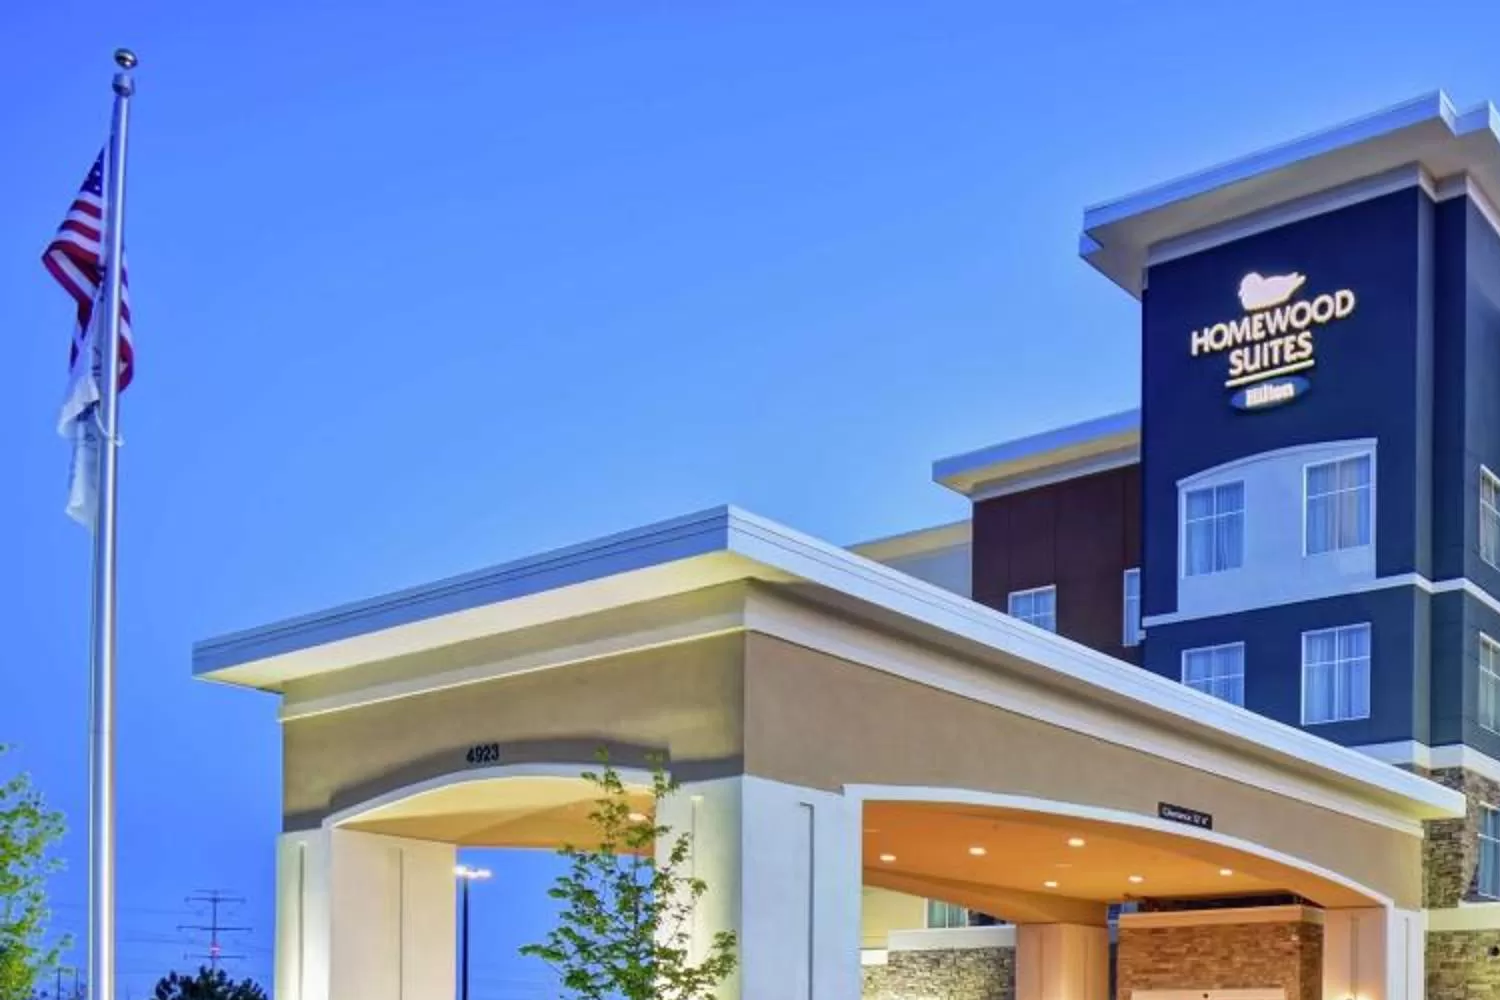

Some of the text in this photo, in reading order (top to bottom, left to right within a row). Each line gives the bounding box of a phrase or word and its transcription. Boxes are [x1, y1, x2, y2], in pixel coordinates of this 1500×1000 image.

[1190, 289, 1356, 356] HOMEWOOD
[1229, 331, 1313, 376] SUITES
[466, 743, 500, 763] 4923
